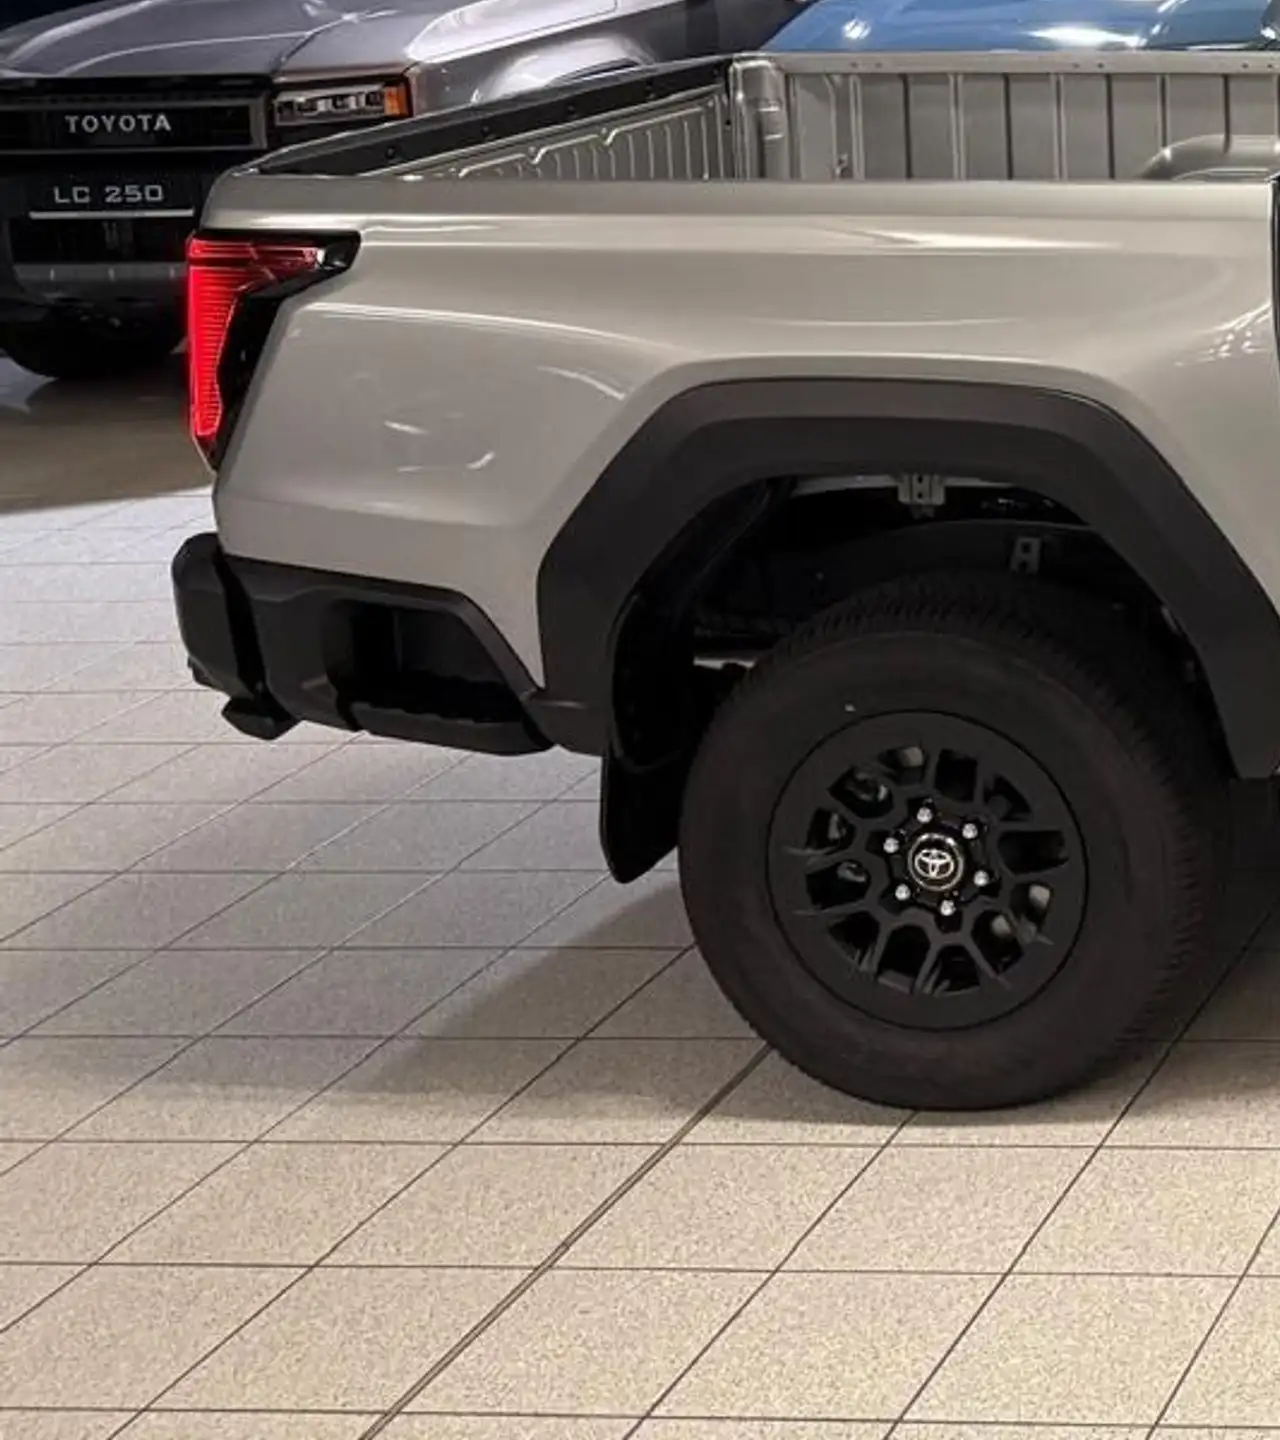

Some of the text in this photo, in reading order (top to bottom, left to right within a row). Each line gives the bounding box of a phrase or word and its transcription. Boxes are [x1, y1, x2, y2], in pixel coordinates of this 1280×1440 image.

[65, 113, 172, 134] TOYOTA
[53, 184, 165, 204] LC 250
